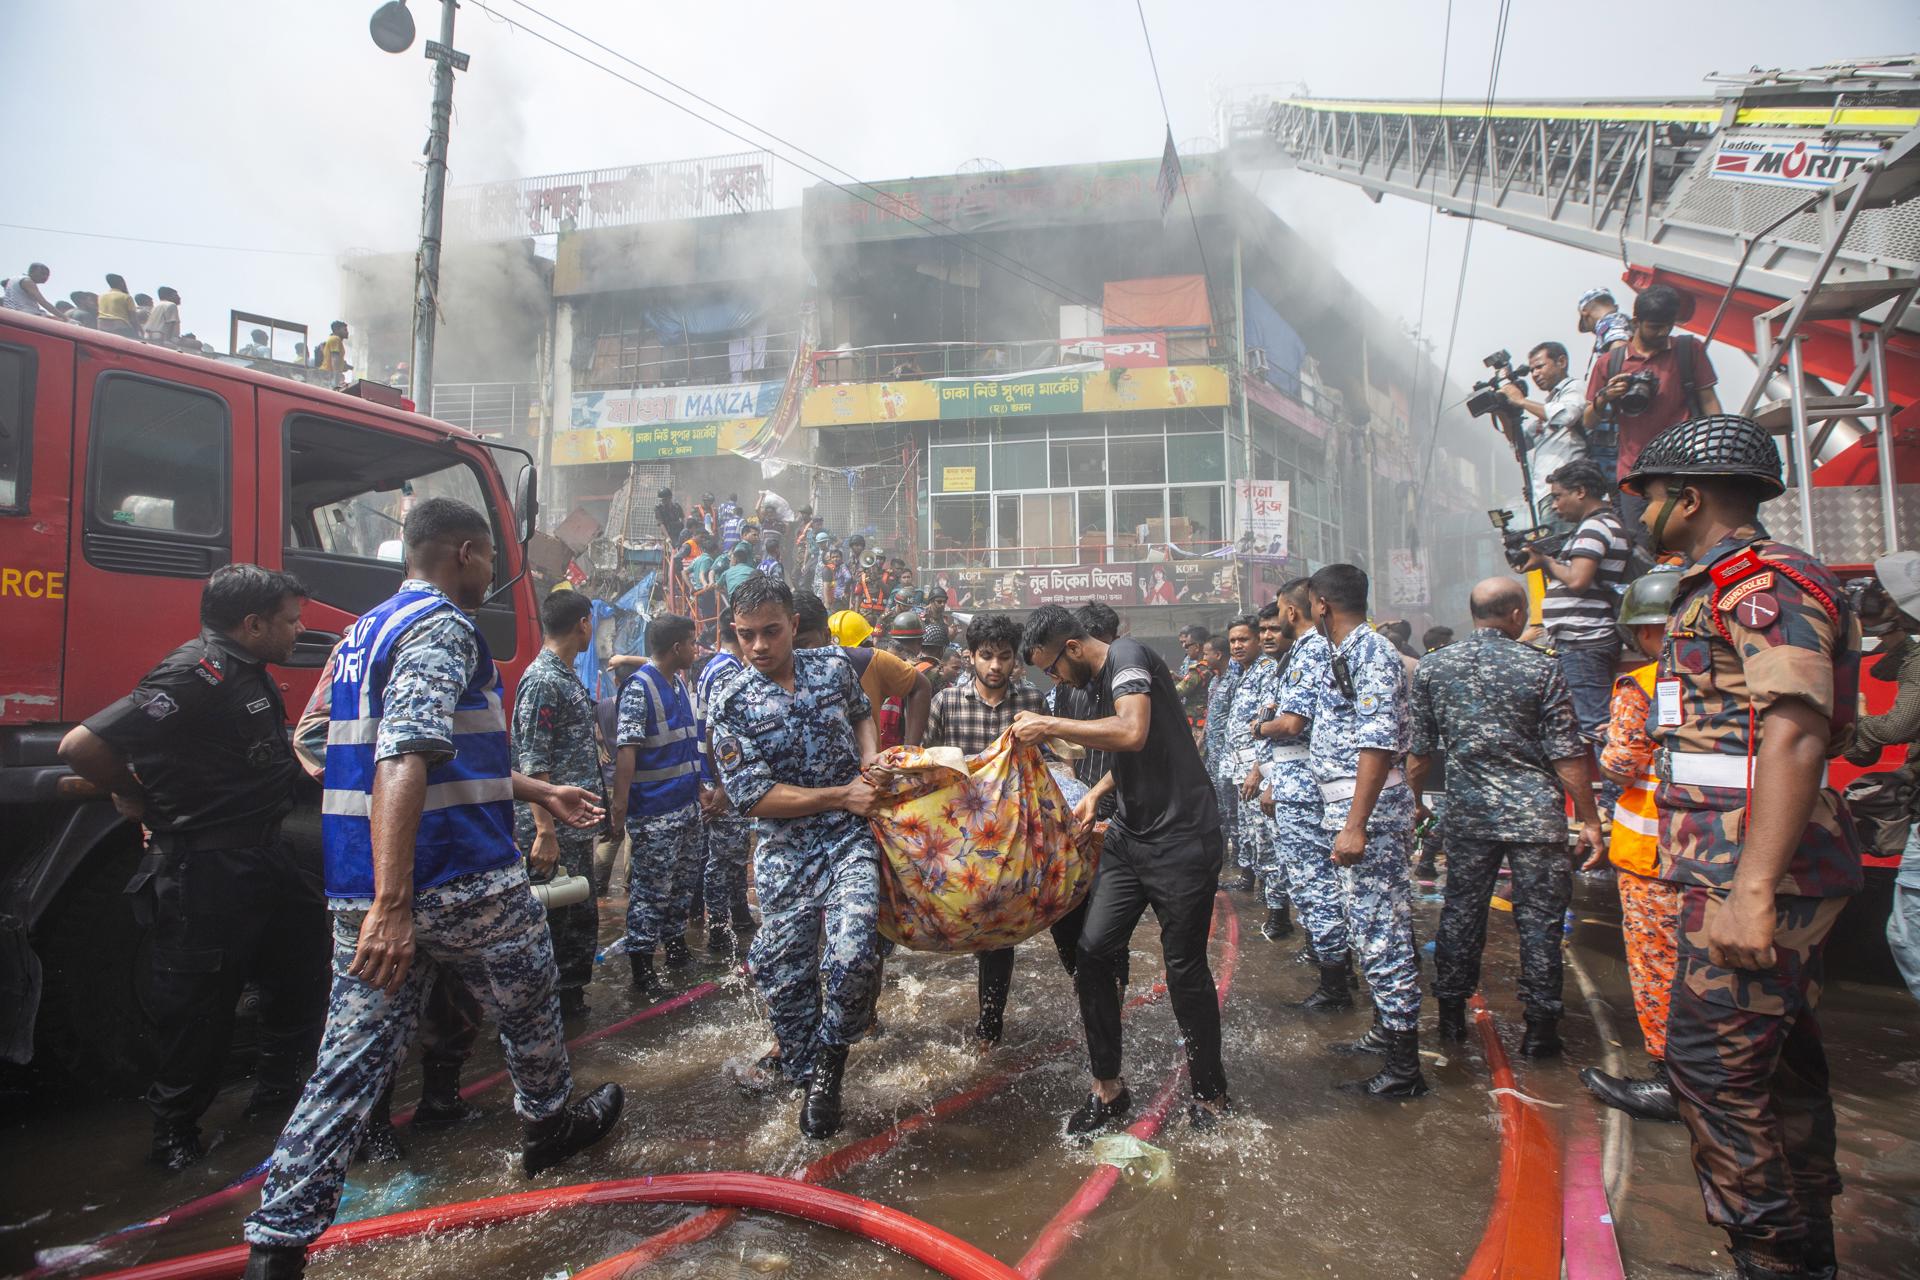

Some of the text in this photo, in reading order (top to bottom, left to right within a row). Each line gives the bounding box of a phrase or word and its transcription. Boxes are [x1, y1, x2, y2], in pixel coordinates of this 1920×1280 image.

[1720, 139, 1767, 151] Ladder
[942, 377, 1080, 402] ঢাকা নিউ সুপার মার্কেট
[685, 392, 753, 417] MANZA
[1011, 401, 1032, 412] ভবন
[1241, 486, 1273, 498] রানা
[1050, 569, 1090, 591] চিকেন
[1091, 567, 1133, 590] ভিলেজ
[1723, 577, 1768, 608] GUARD POLICE
[345, 616, 376, 648] AIR
